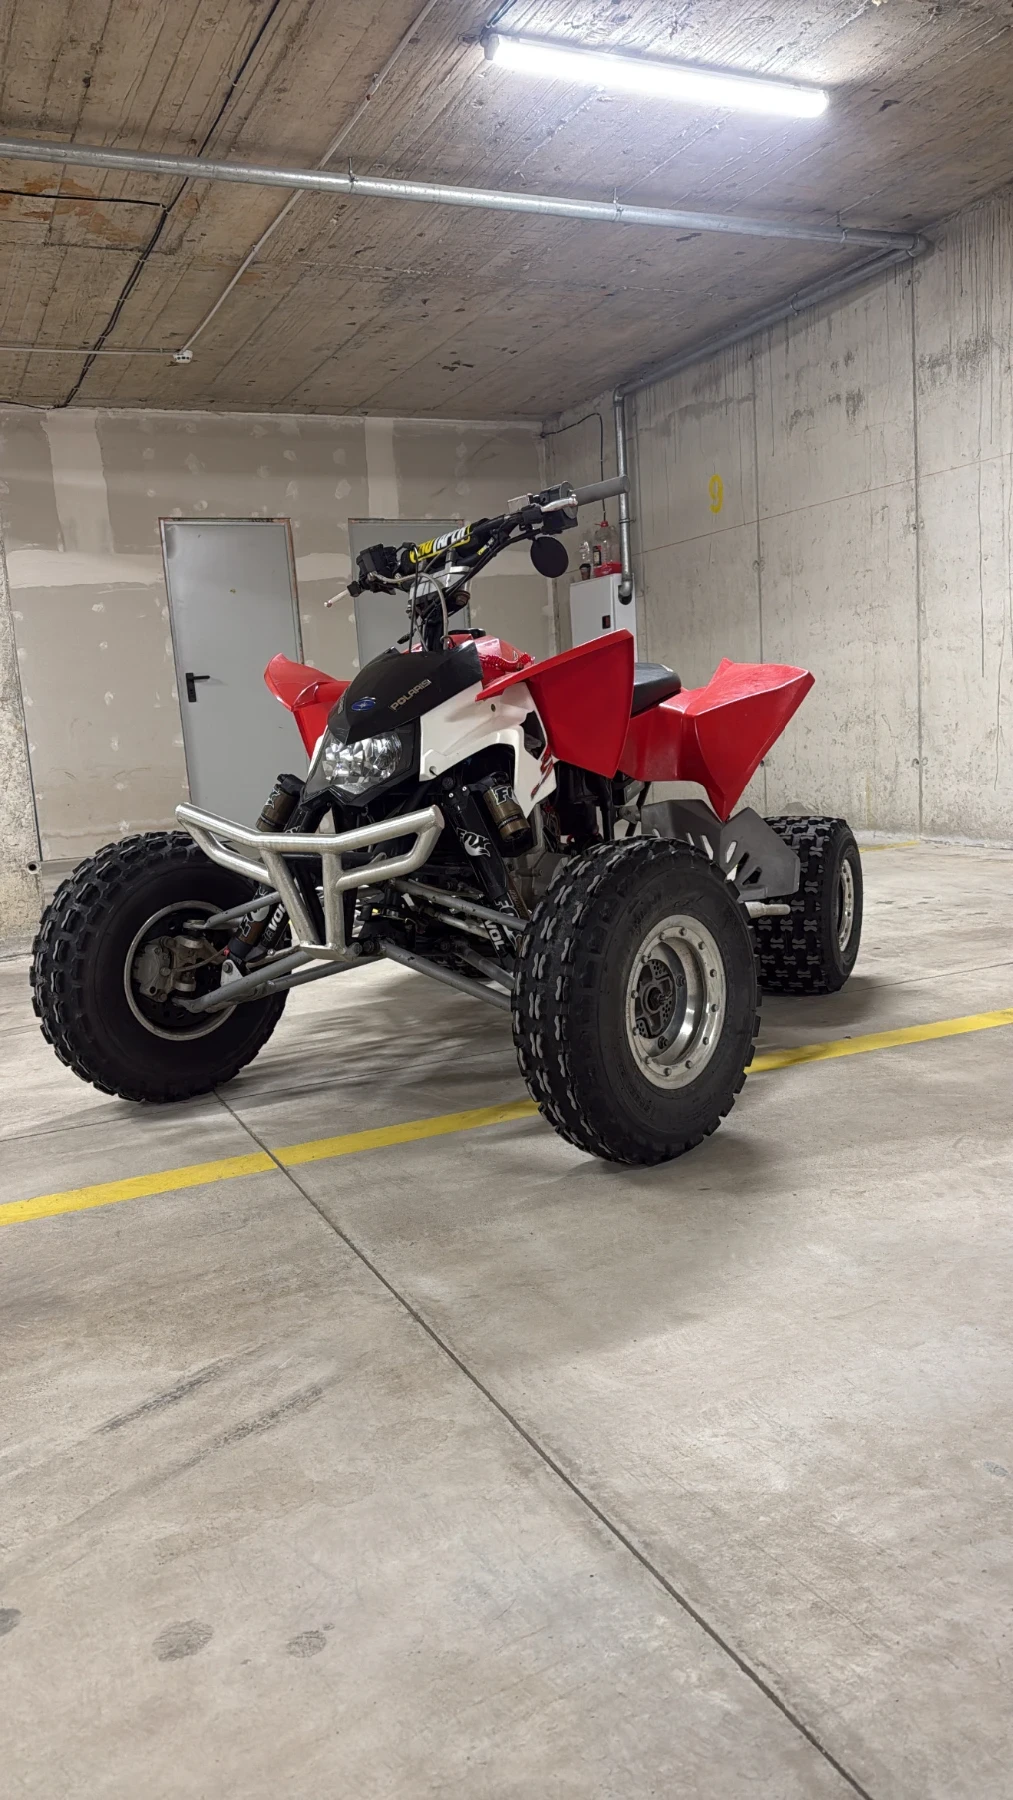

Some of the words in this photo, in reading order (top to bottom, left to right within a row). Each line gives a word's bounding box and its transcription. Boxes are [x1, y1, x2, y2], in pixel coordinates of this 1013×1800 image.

[708, 474, 723, 514] 9
[389, 679, 432, 712] POLARIS
[456, 827, 491, 857] FOX
